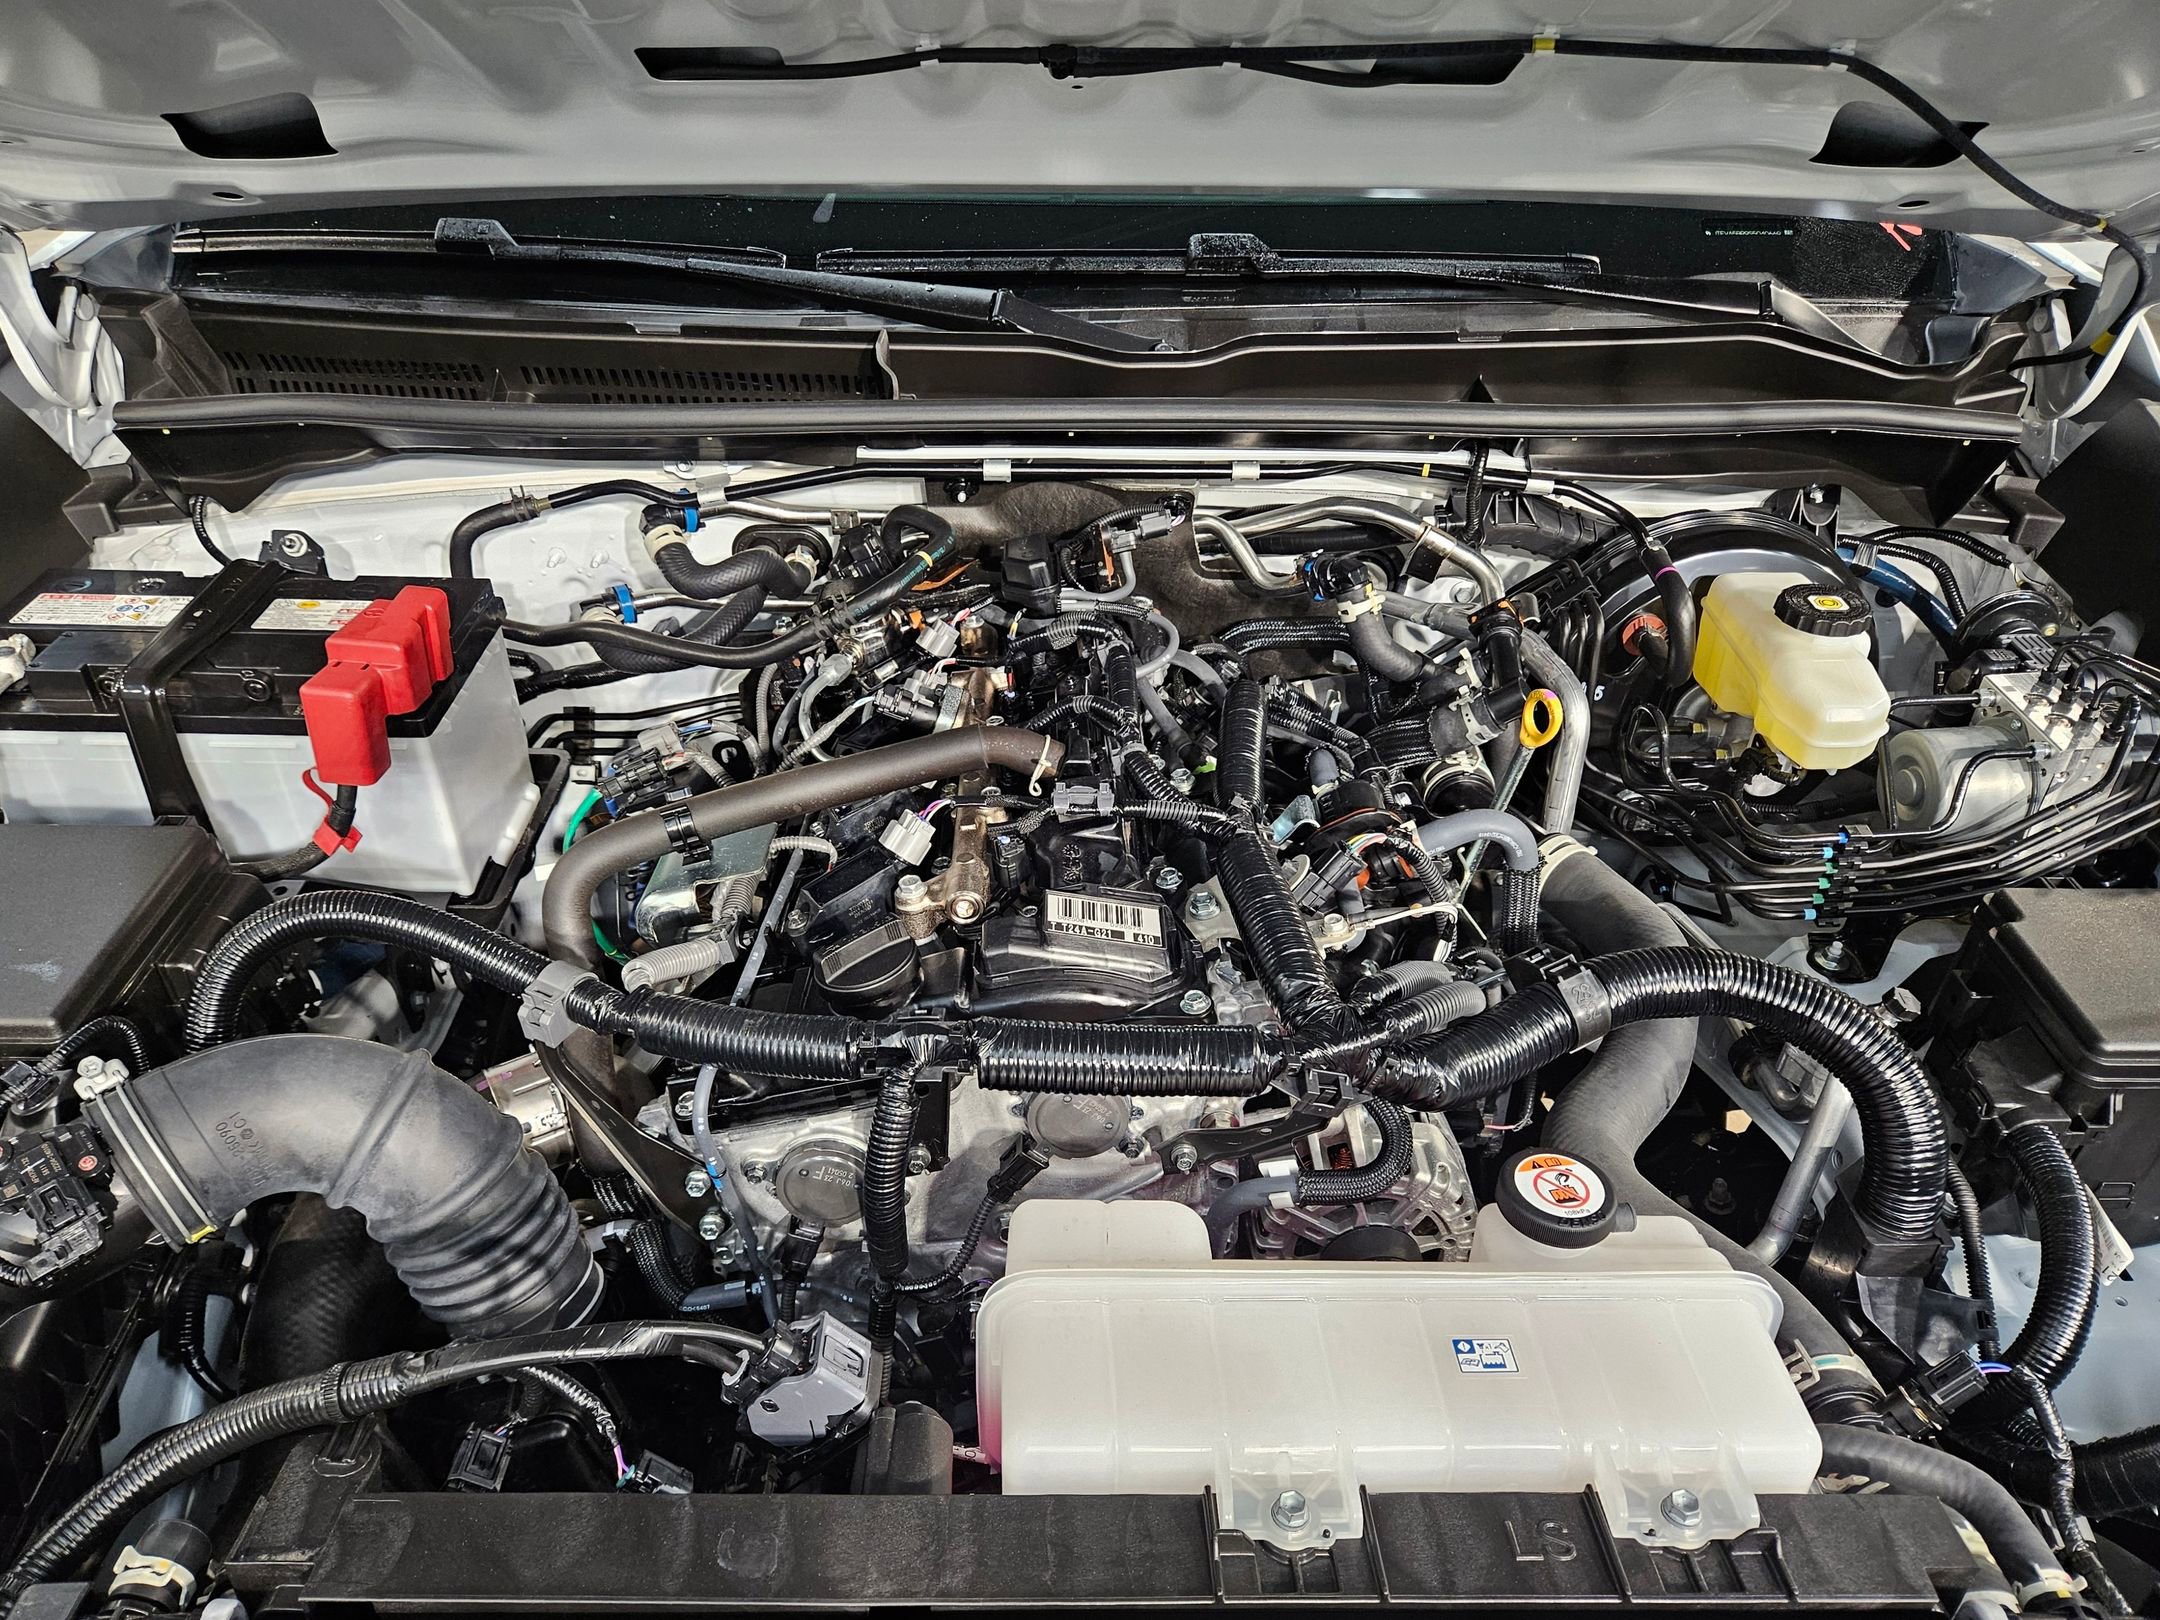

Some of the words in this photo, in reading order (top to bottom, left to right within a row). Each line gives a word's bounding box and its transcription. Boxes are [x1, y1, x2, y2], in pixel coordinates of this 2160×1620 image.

[1062, 923, 1112, 939] T24A-G21
[1137, 934, 1155, 944] 410
[812, 1166, 825, 1181] F
[836, 1178, 851, 1187] 06J
[1504, 1518, 1577, 1562] LS
